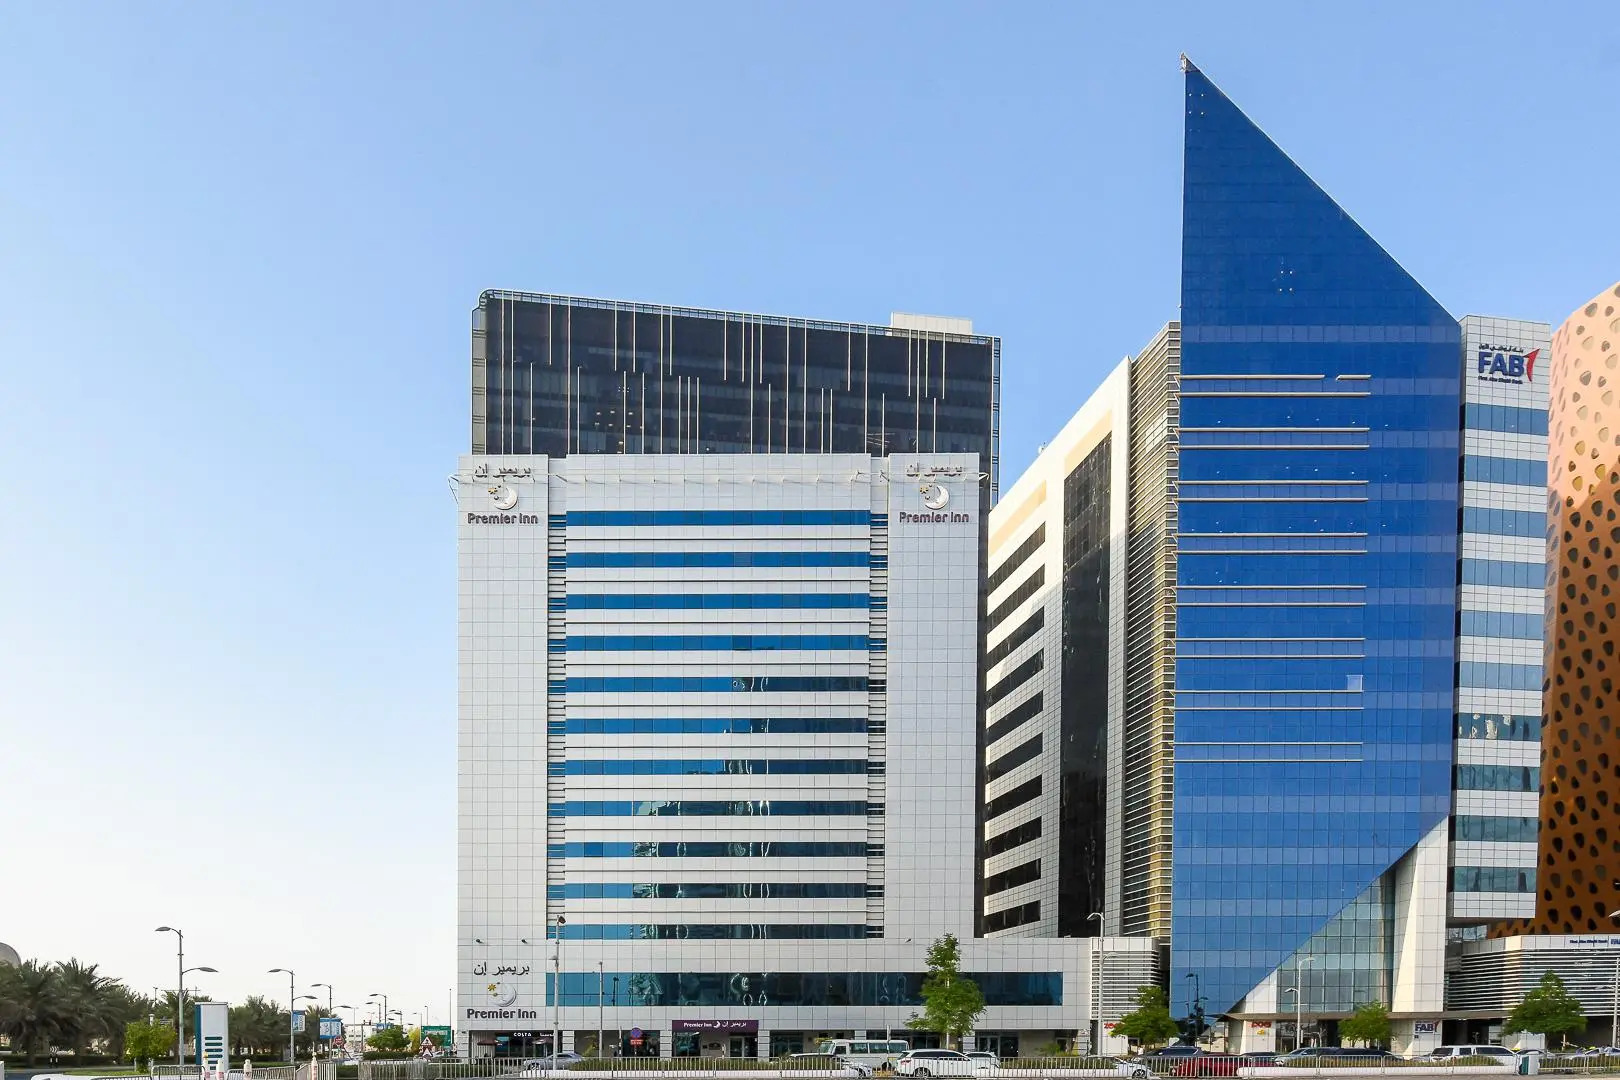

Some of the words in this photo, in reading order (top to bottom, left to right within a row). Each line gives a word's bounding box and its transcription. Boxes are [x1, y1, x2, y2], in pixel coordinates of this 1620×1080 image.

[1478, 351, 1525, 377] FAB
[467, 512, 517, 524] Premier
[519, 512, 538, 524] Inn
[899, 511, 948, 523] Premier
[950, 511, 969, 523] Inn
[473, 961, 487, 975] إن
[492, 965, 530, 975] بريمير
[466, 1008, 516, 1019] Premier
[518, 1008, 537, 1019] Inn
[1415, 1023, 1433, 1031] FAB
